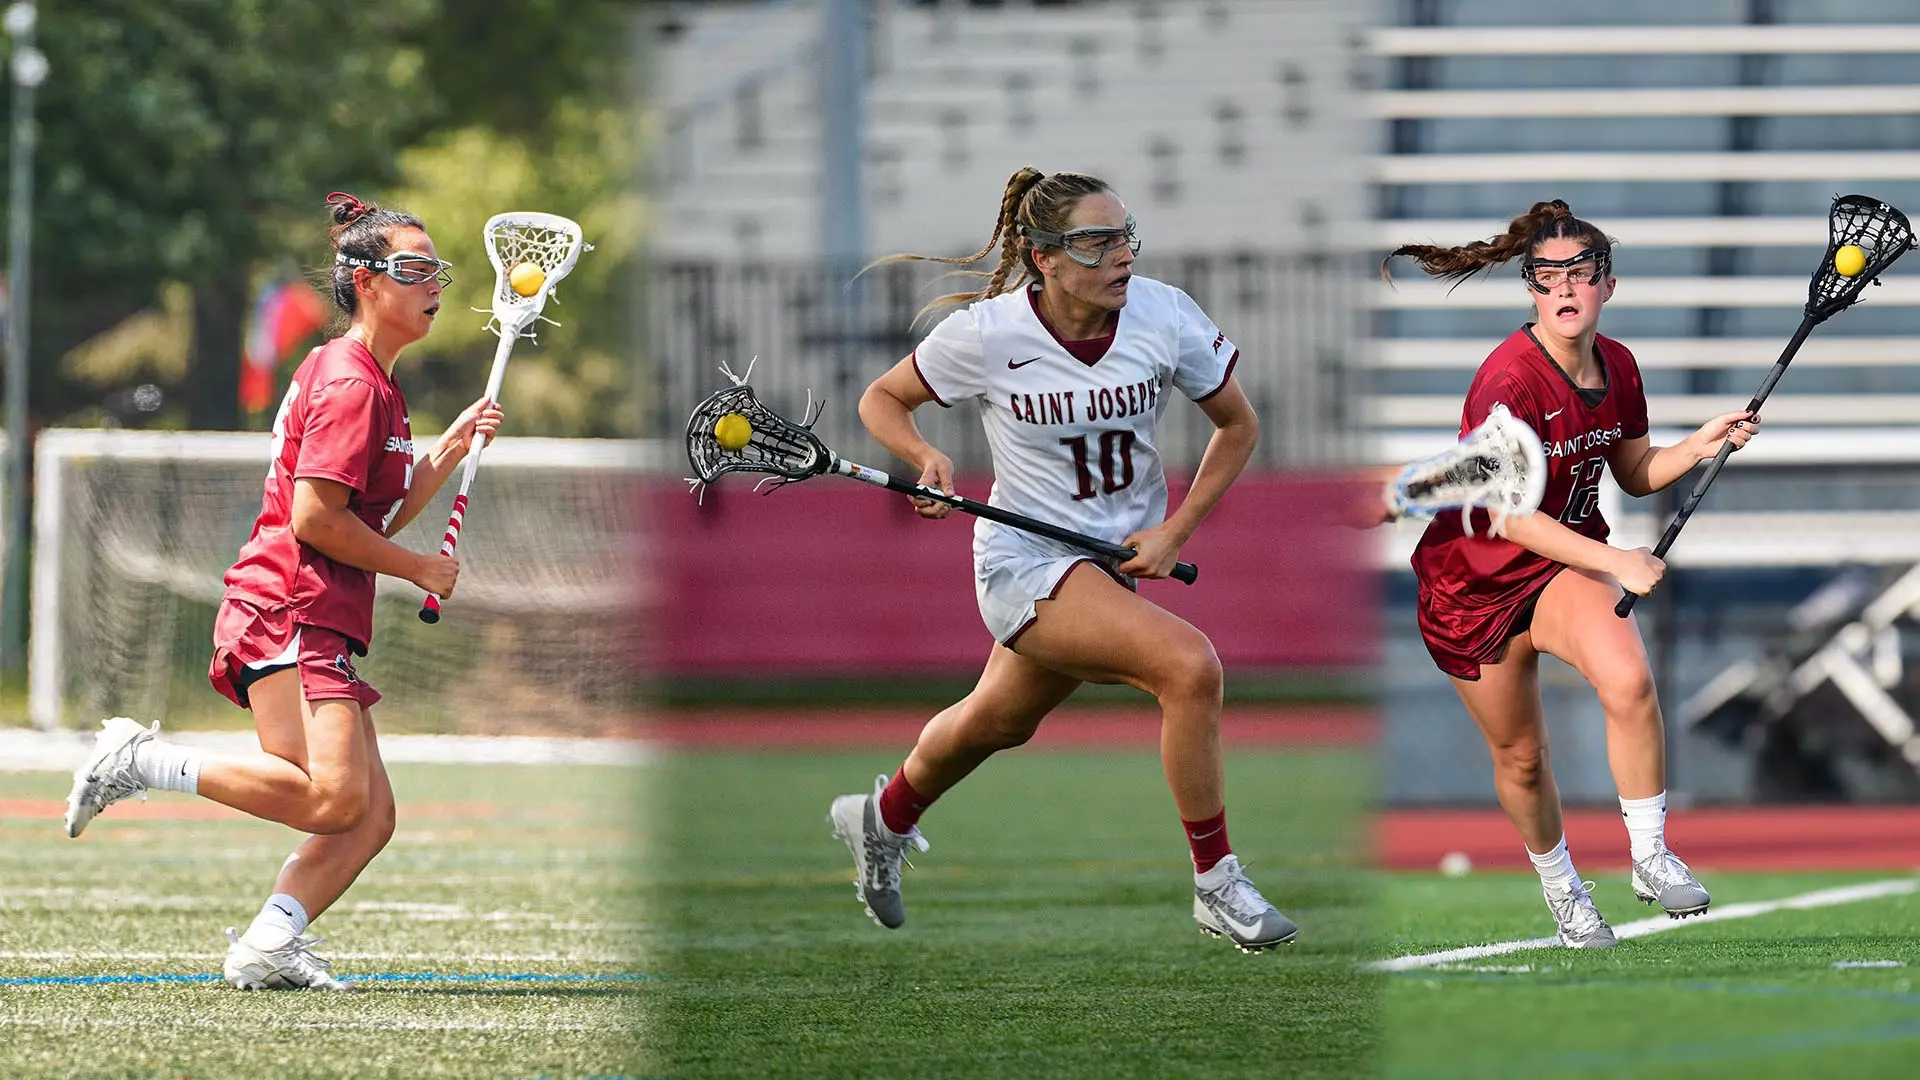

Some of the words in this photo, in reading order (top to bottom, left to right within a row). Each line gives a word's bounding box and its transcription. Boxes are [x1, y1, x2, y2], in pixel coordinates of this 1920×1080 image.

[349, 257, 371, 267] GAIT
[1010, 392, 1075, 425] SAINT
[1543, 434, 1583, 457] SAINT
[1058, 430, 1137, 501] 10
[1557, 455, 1606, 524] 12
